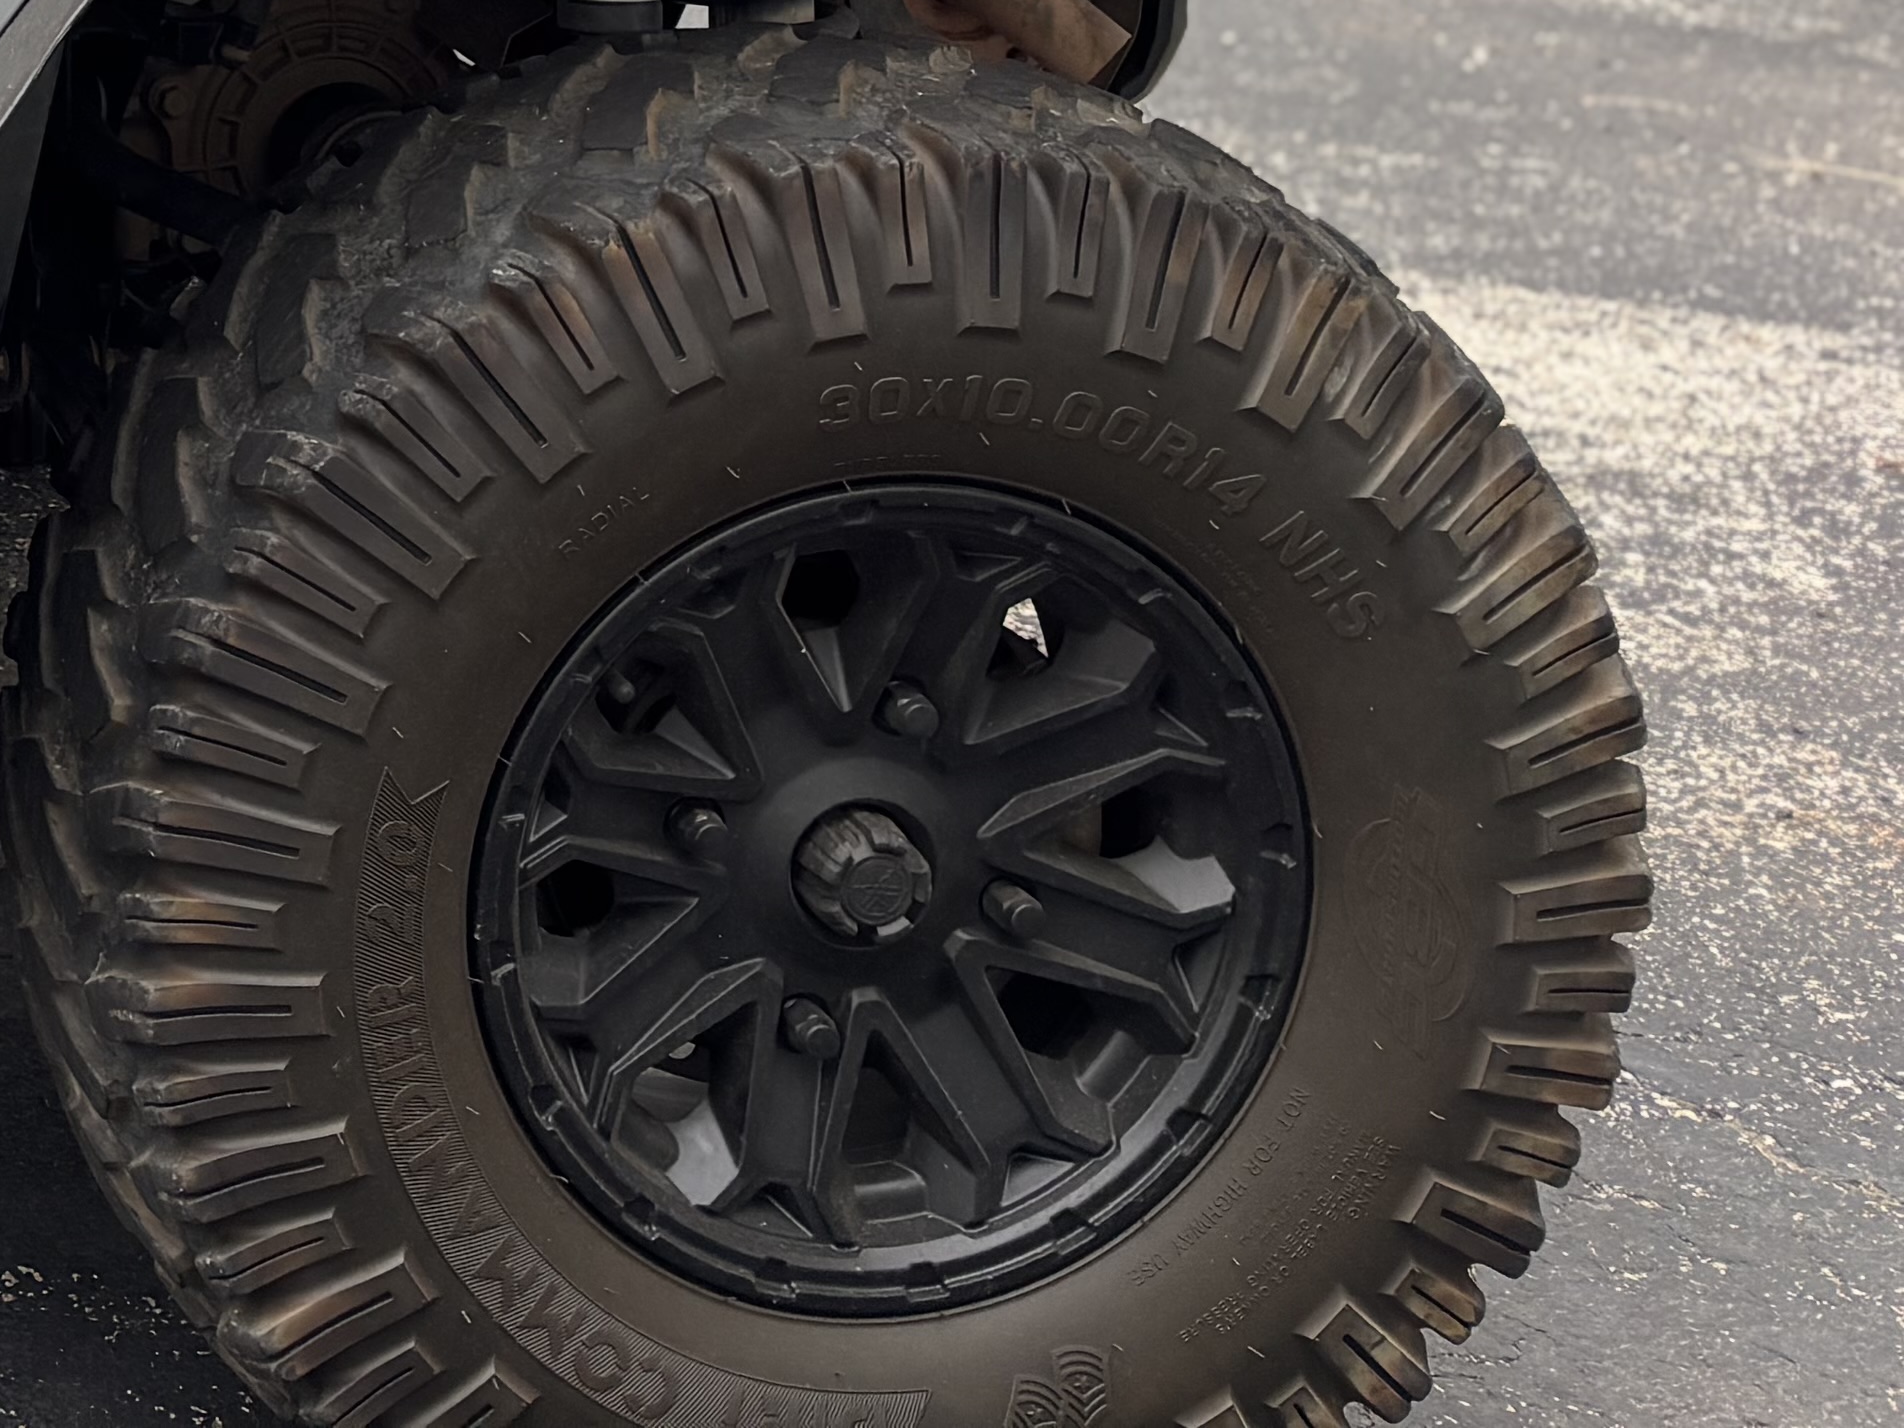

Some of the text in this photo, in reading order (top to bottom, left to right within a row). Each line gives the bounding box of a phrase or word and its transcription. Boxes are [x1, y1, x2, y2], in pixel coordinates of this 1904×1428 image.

[556, 481, 651, 561] RADIAL
[1259, 510, 1387, 641] NHS
[366, 819, 425, 945] 2.0
[1125, 1085, 1311, 1289] NOT FOR HIGHWAY USE
